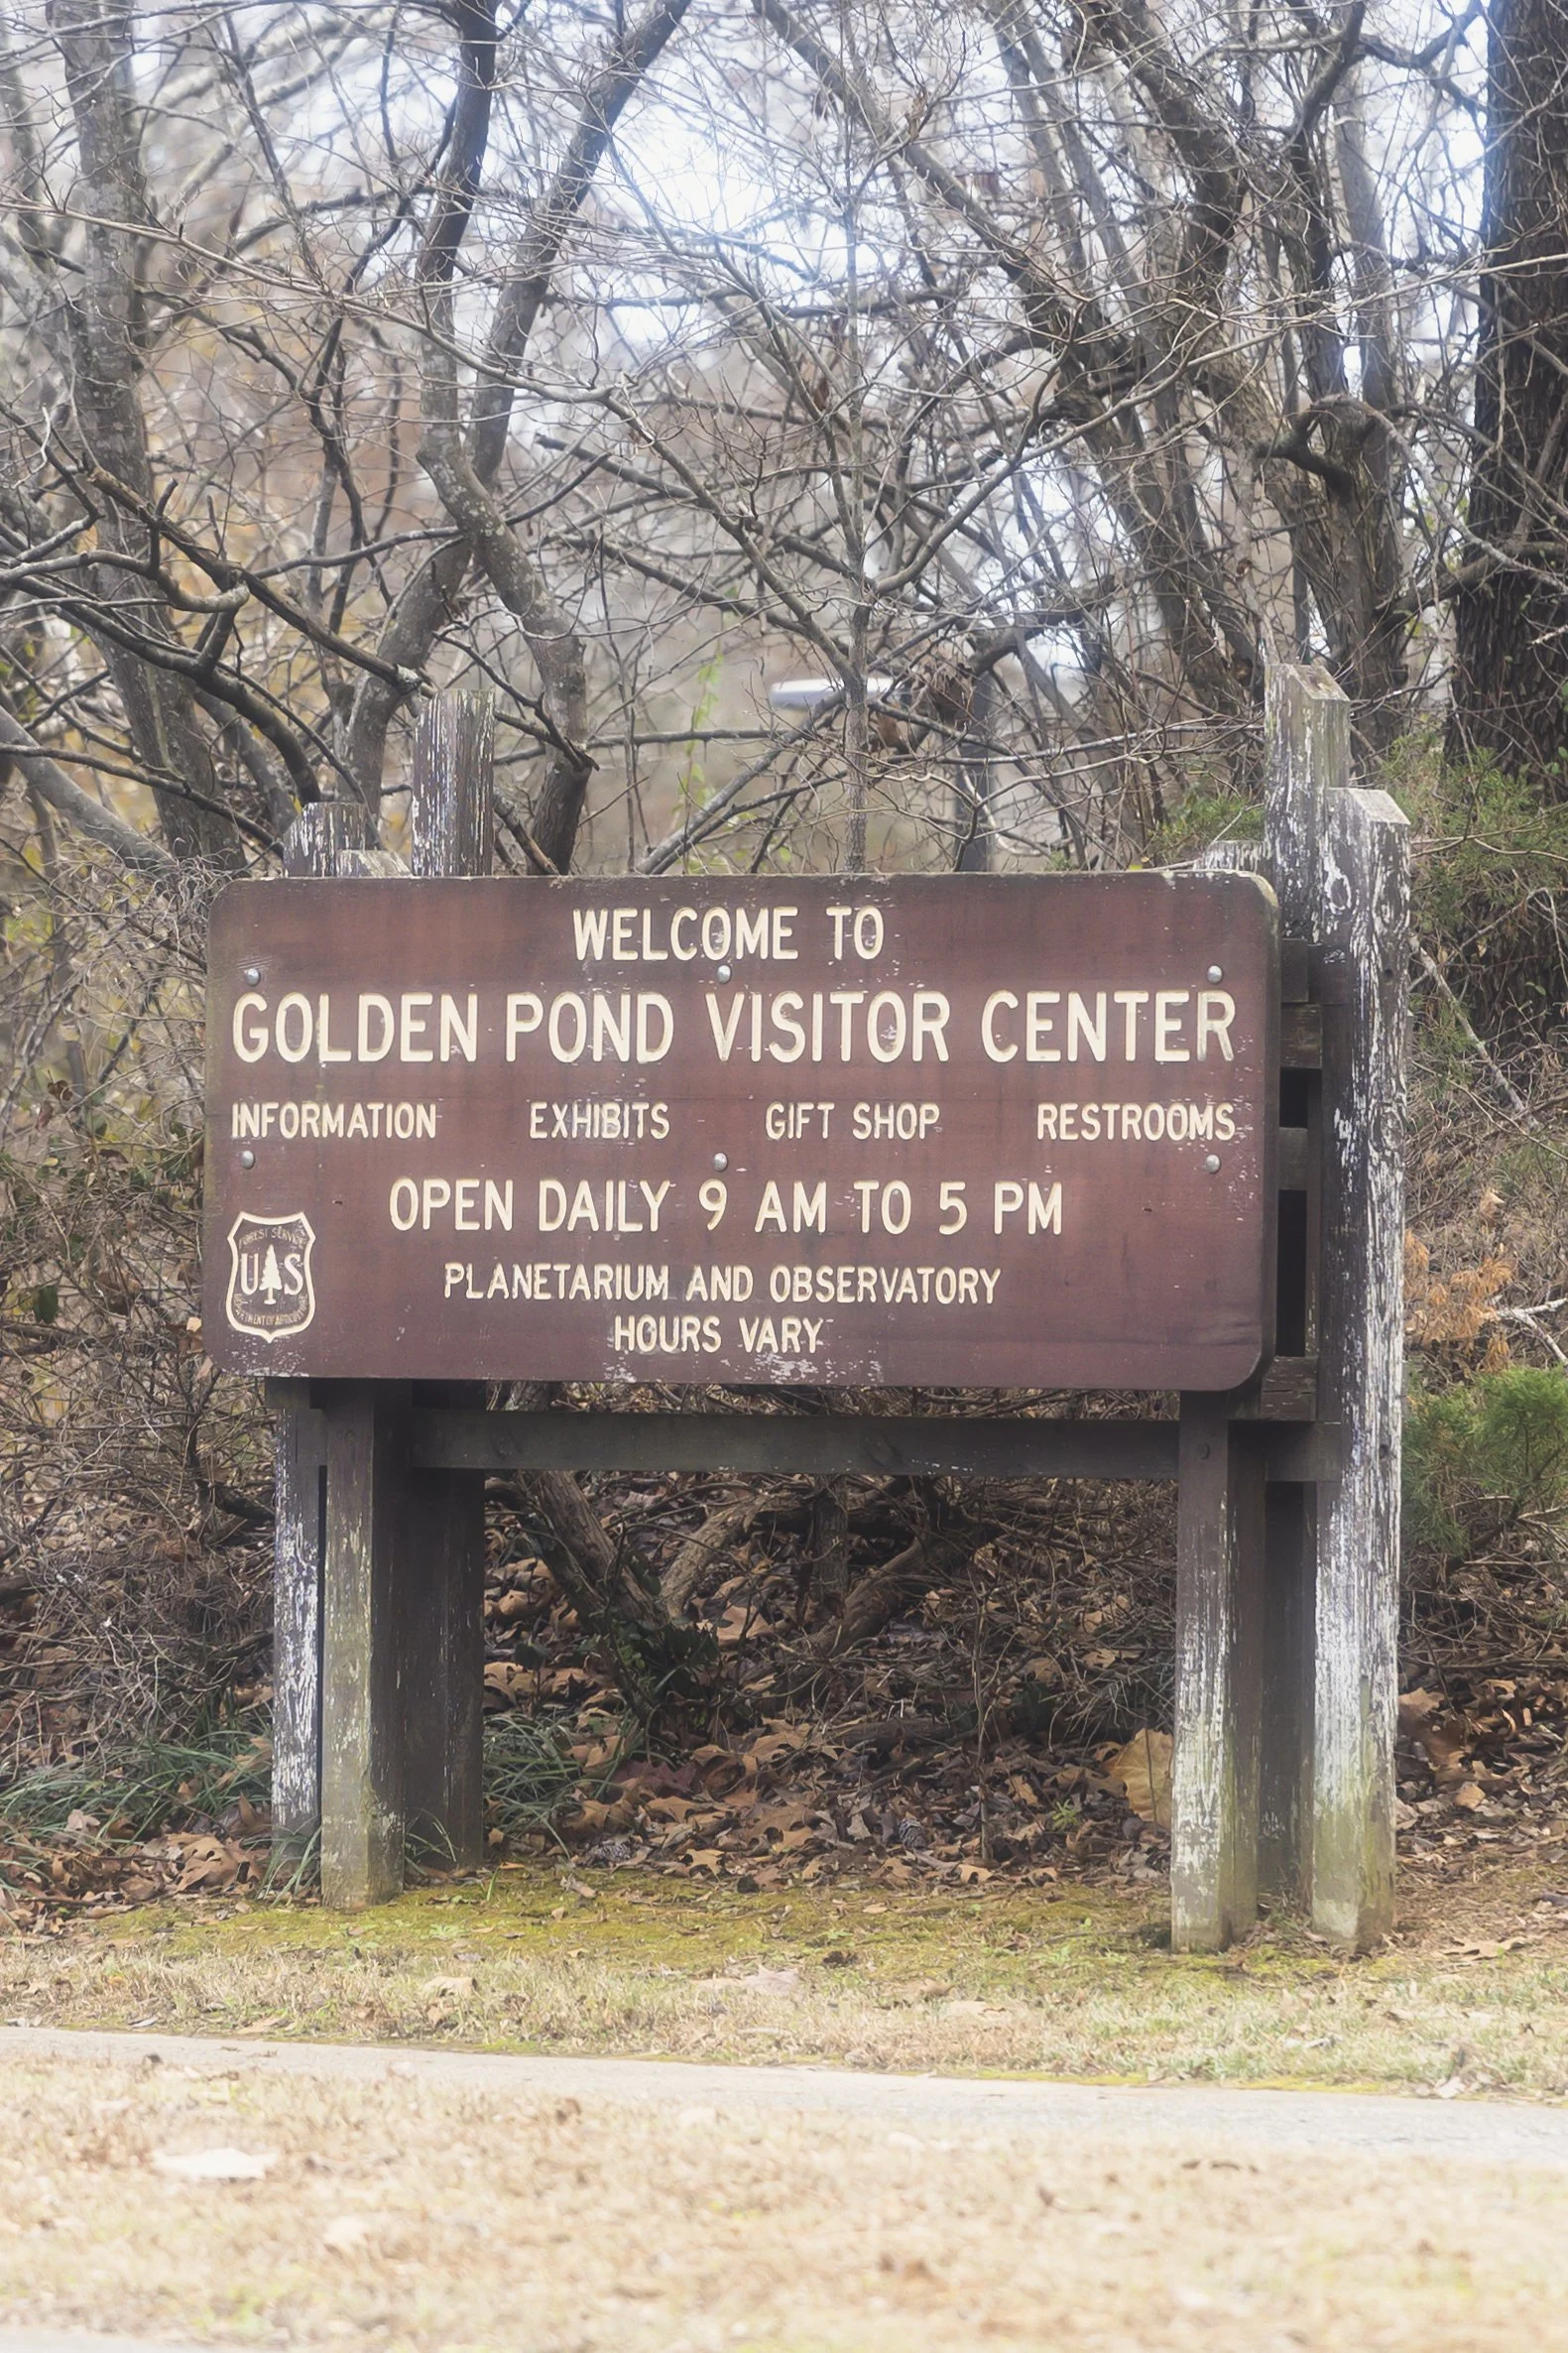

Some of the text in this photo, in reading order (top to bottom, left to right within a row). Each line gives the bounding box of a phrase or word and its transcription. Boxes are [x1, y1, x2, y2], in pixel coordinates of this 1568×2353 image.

[572, 907, 885, 961] WELCOME TO
[232, 991, 1236, 1064] GOLDEN POND VISITOR CENTER
[231, 1101, 436, 1140] INFORMATION
[529, 1101, 669, 1140] EXHIBITS
[765, 1102, 940, 1140] GIFT SHOP
[1036, 1102, 1236, 1141] RESTROOMS
[389, 1177, 1063, 1236] OPEN DAILY 9 AM TO 5 PM
[443, 1263, 1002, 1305] PLANETARIUM AND OBSERVATORY
[614, 1315, 824, 1354] HOURS VARY
